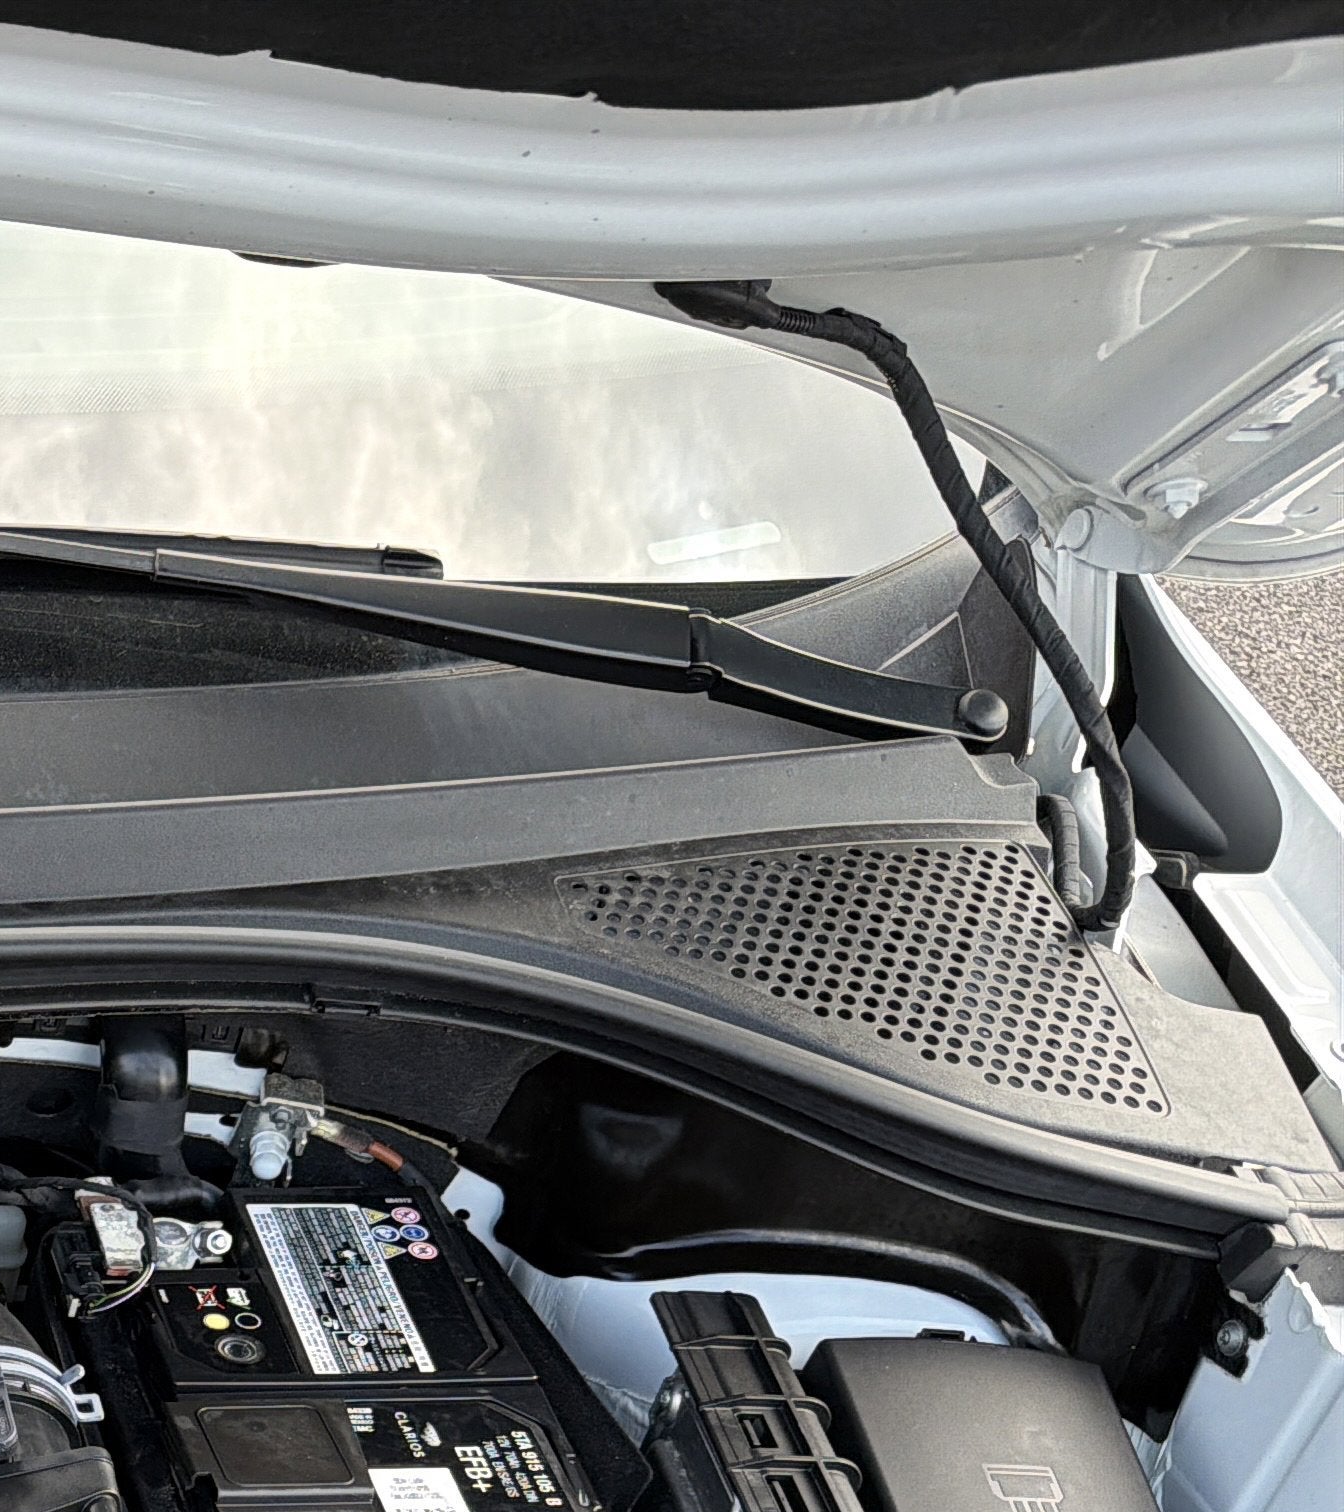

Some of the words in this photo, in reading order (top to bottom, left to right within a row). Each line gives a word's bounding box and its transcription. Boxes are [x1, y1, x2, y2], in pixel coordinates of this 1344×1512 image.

[394, 1411, 426, 1458] CLARIOS
[511, 1430, 533, 1450] 5TA
[454, 1445, 494, 1493] EFB+
[521, 1451, 545, 1472] 915
[533, 1473, 556, 1493] 105
